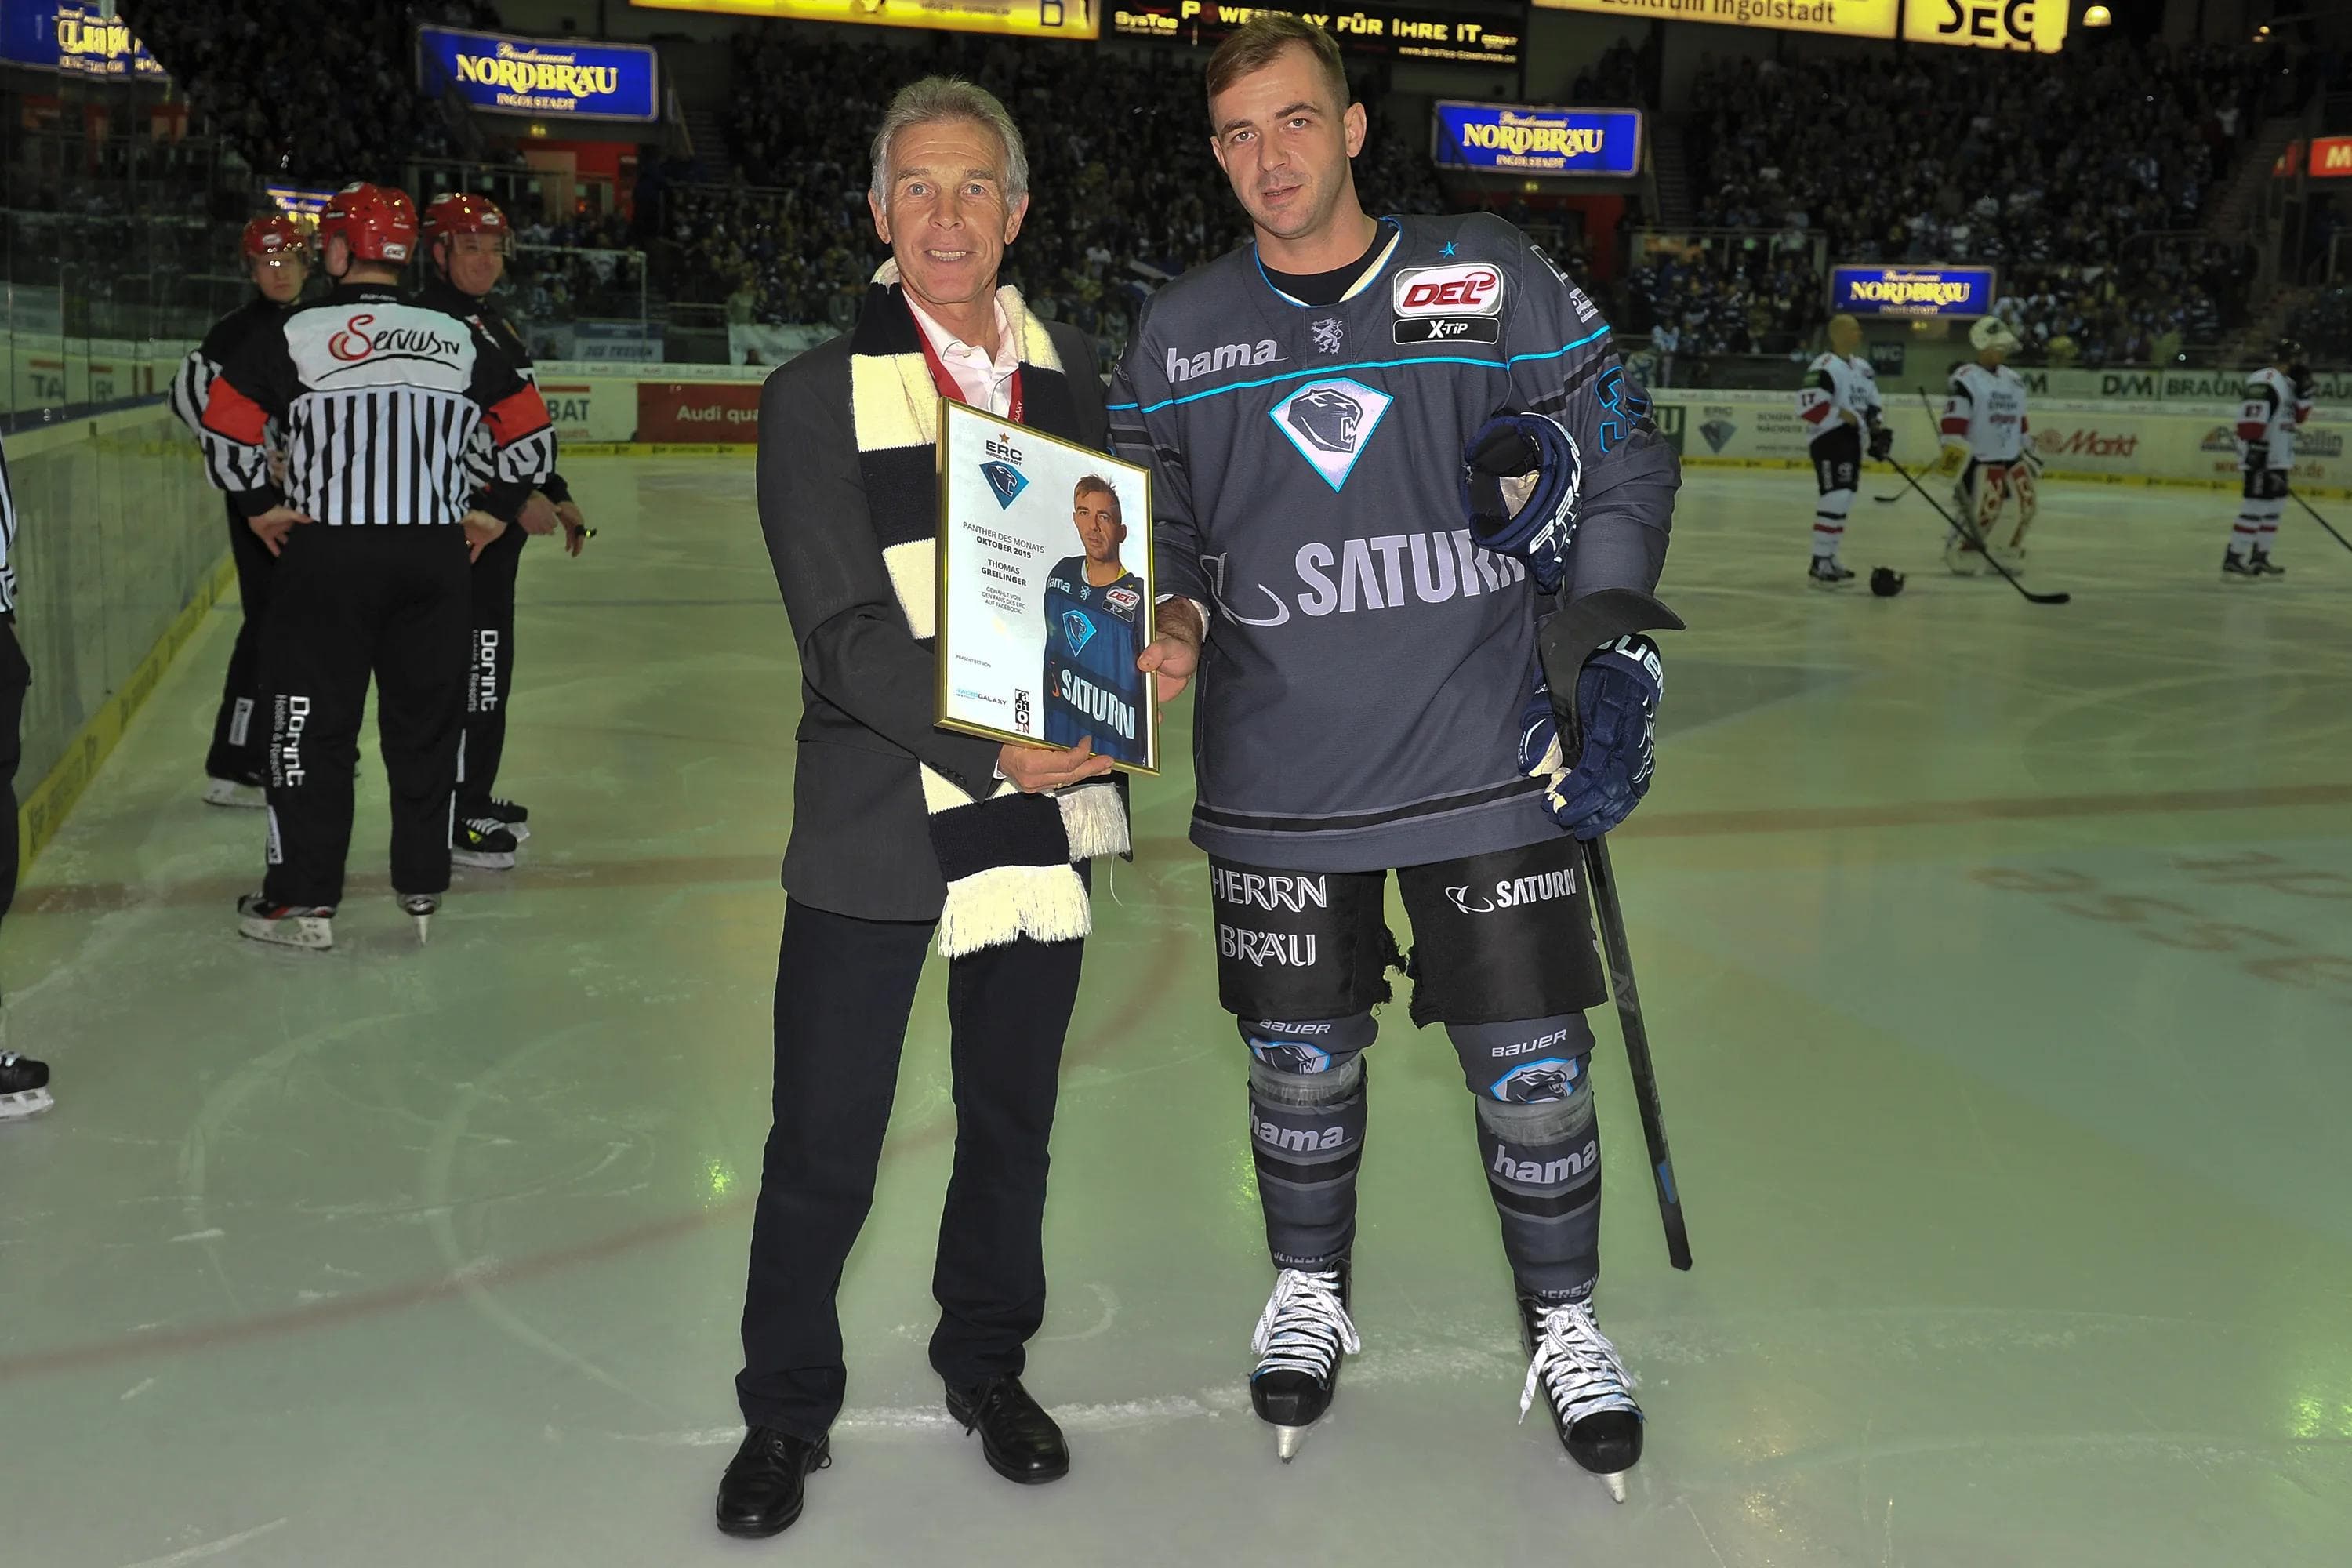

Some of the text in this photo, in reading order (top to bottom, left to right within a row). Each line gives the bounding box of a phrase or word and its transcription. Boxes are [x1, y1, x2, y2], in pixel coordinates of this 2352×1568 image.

[1714, 0, 1835, 23] Ingolstadt
[1337, 12, 1384, 36] FÜR
[1392, 18, 1448, 41] IHRE
[1457, 24, 1482, 43] IT
[456, 53, 619, 98] NORDBRÄU
[1462, 123, 1605, 157] NORDBRÄU
[1403, 276, 1488, 307] DEL
[1850, 281, 1970, 306] NORDBRÄU
[1167, 339, 1278, 383] hama
[677, 405, 721, 422] Audi
[985, 440, 1022, 462] ERC
[985, 451, 1022, 466] INGOLSTADT
[963, 521, 1045, 554] PANTHER DES MONATS
[976, 536, 1032, 558] OKTOBER 2015
[981, 567, 1027, 586] GREILINGER
[988, 559, 1020, 575] THOMAS
[982, 591, 992, 600] DEN
[993, 594, 1005, 604] FANS
[1006, 597, 1016, 606] DES
[1010, 593, 1021, 601] VON
[1109, 590, 1136, 605] DEL
[481, 630, 499, 712] Dorint
[274, 694, 288, 731] Hotels
[1062, 669, 1135, 740] SATURN
[282, 695, 310, 787] Dorint
[270, 743, 283, 788] Resorts
[1212, 865, 1327, 913] HERRN
[1496, 868, 1577, 909] SATURN
[1219, 924, 1316, 967] BRÄU
[1259, 1019, 1332, 1035] BAUER
[1492, 1029, 1567, 1058] BAUER
[1250, 1102, 1345, 1152] hama
[1494, 1140, 1598, 1185] hama
